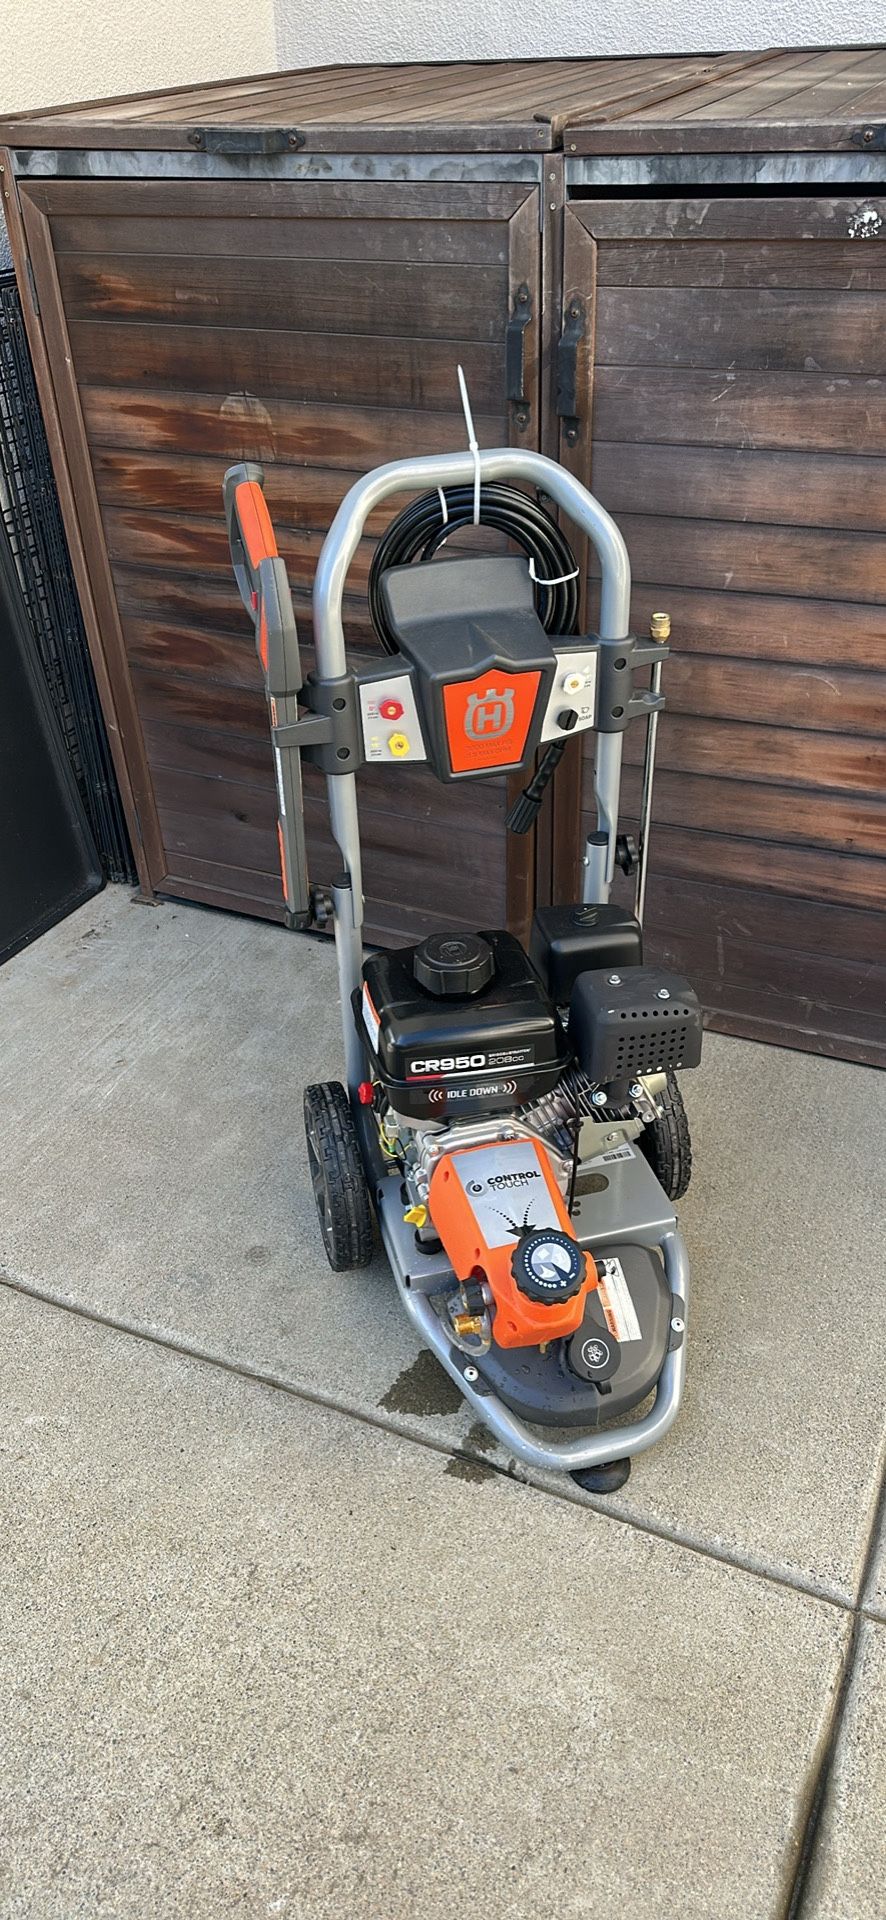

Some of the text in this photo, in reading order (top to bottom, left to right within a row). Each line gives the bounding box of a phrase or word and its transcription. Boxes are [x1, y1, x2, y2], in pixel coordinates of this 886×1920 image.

[410, 1054, 486, 1073] CR950
[447, 1085, 499, 1099] IDLE DOWN
[487, 1171, 541, 1185] CONTROL
[489, 1180, 529, 1191] TOUCH
